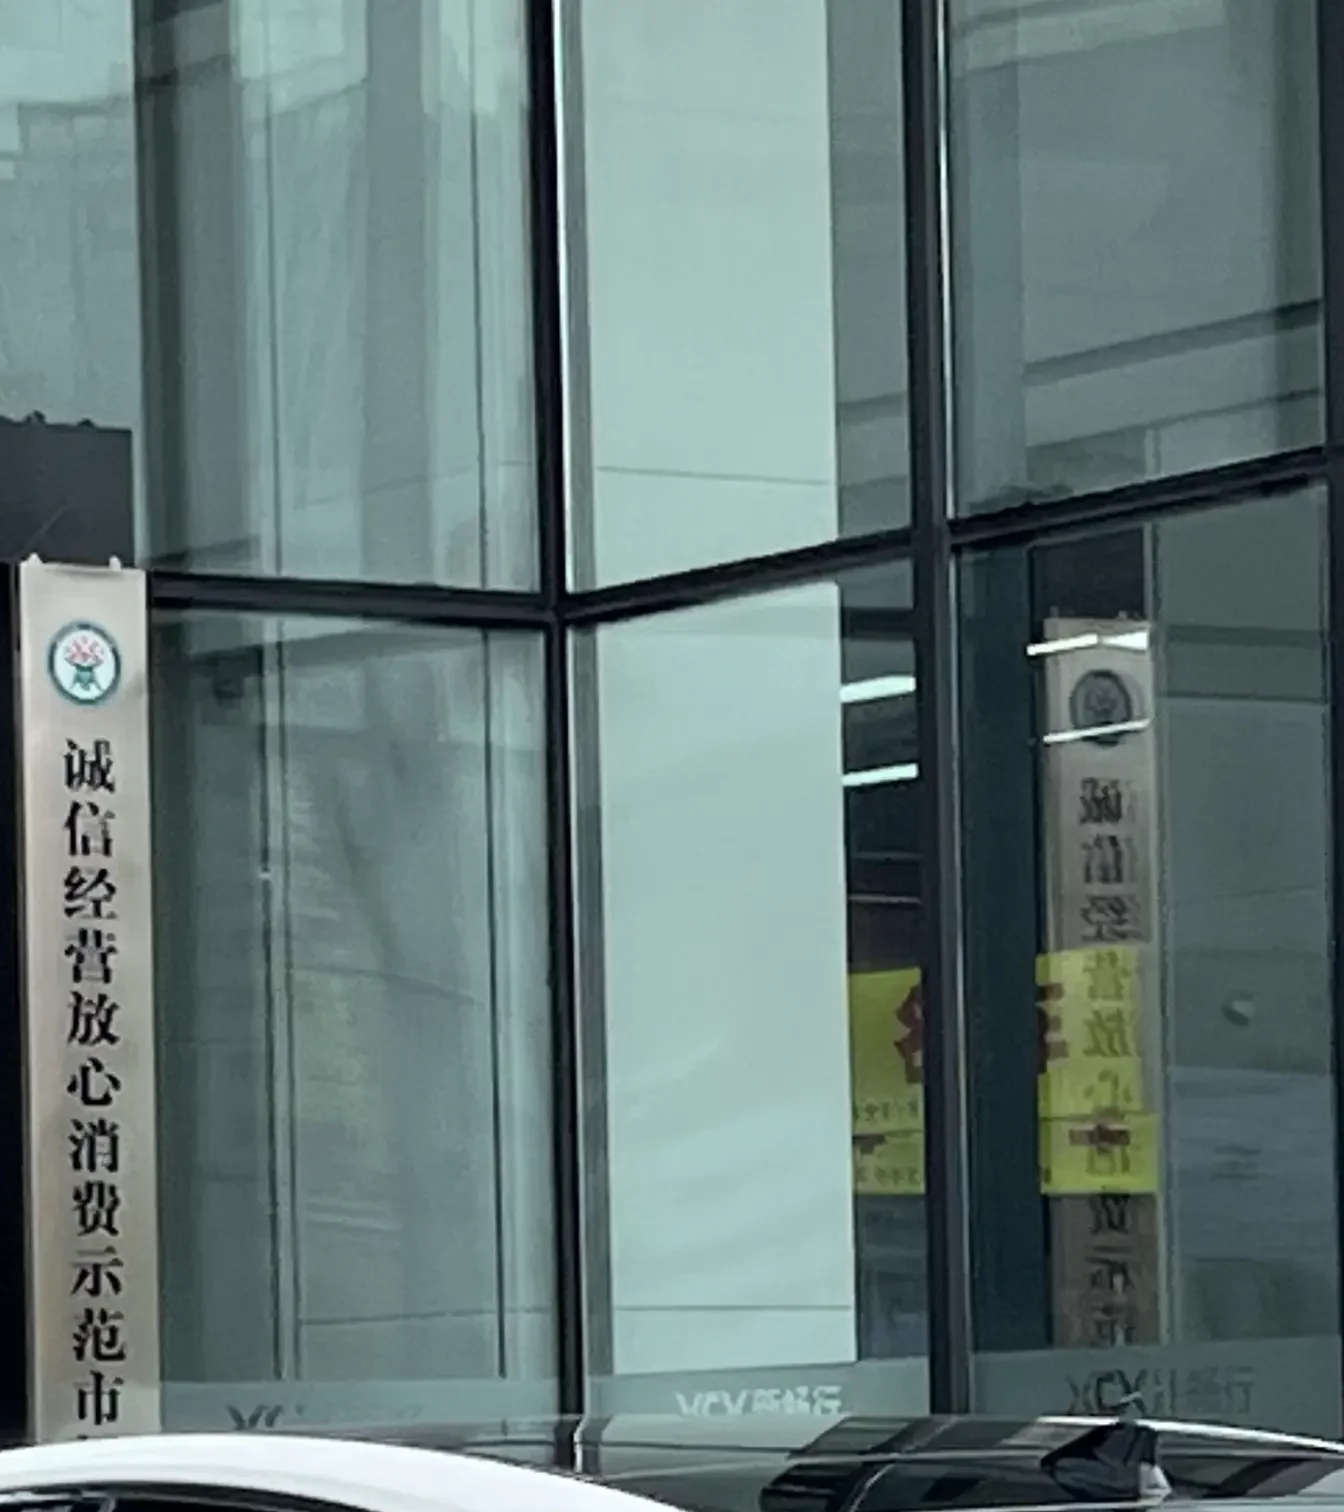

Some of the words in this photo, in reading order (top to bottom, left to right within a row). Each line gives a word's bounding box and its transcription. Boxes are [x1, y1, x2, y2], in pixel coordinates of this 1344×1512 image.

[62, 738, 127, 1440] 诚信经营放心消费示范市
